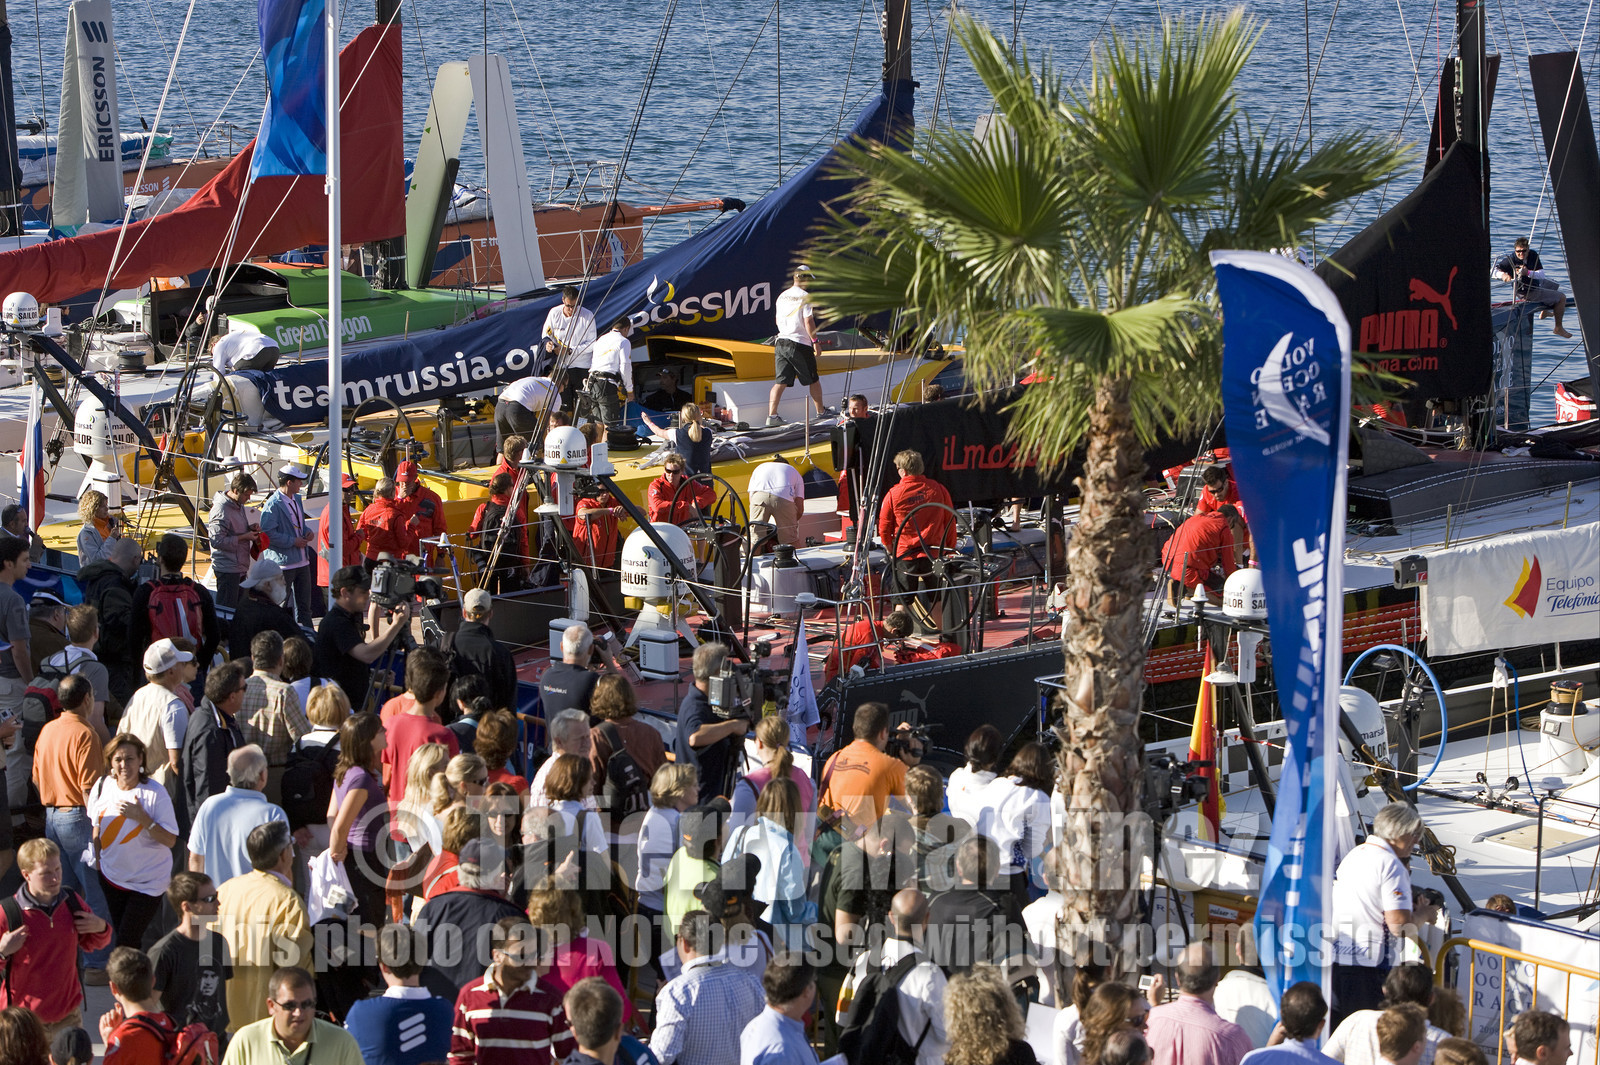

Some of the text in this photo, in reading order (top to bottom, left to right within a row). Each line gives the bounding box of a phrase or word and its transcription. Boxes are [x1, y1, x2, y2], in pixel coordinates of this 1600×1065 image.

[92, 56, 115, 162] ERICSSON
[275, 322, 321, 347] Green
[1359, 309, 1439, 353] PUMA
[1546, 575, 1595, 593] Equipo
